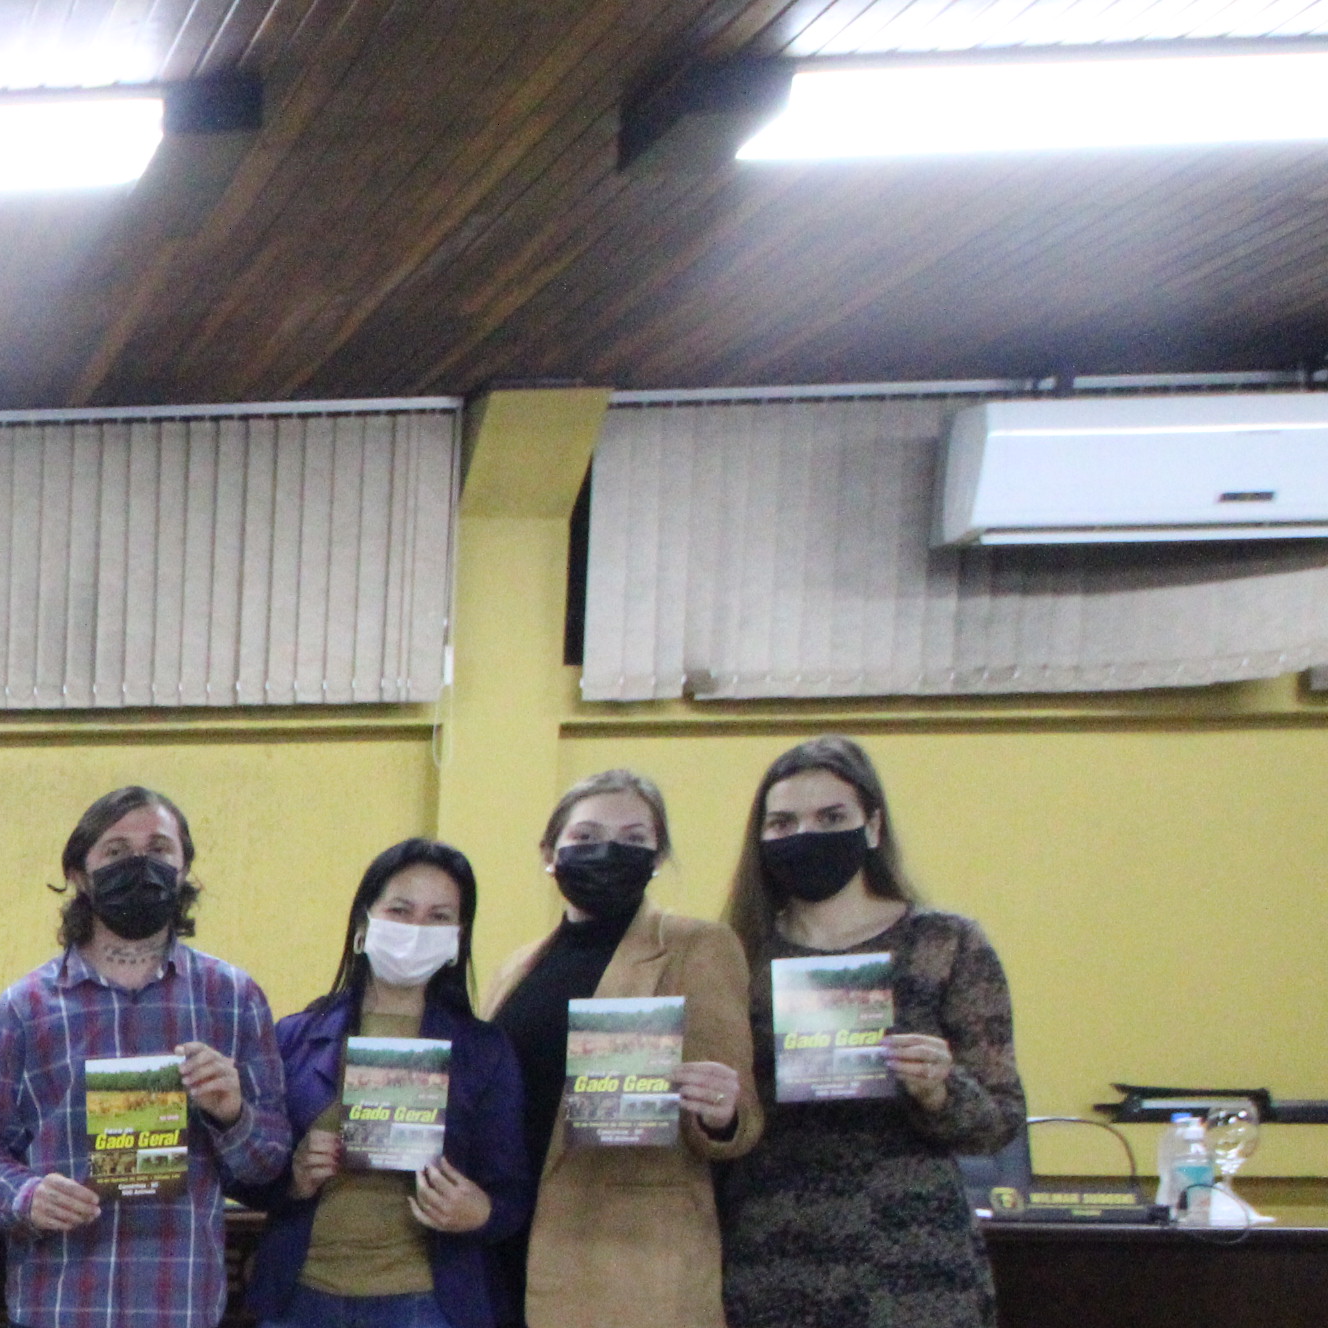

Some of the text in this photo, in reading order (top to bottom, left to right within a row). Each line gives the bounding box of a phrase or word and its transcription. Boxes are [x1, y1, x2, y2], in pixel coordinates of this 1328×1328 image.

[784, 1032, 832, 1050] Gado
[574, 1076, 619, 1092] Gado
[349, 1105, 438, 1123] Gado Geral
[96, 1130, 180, 1150] Gado Geral
